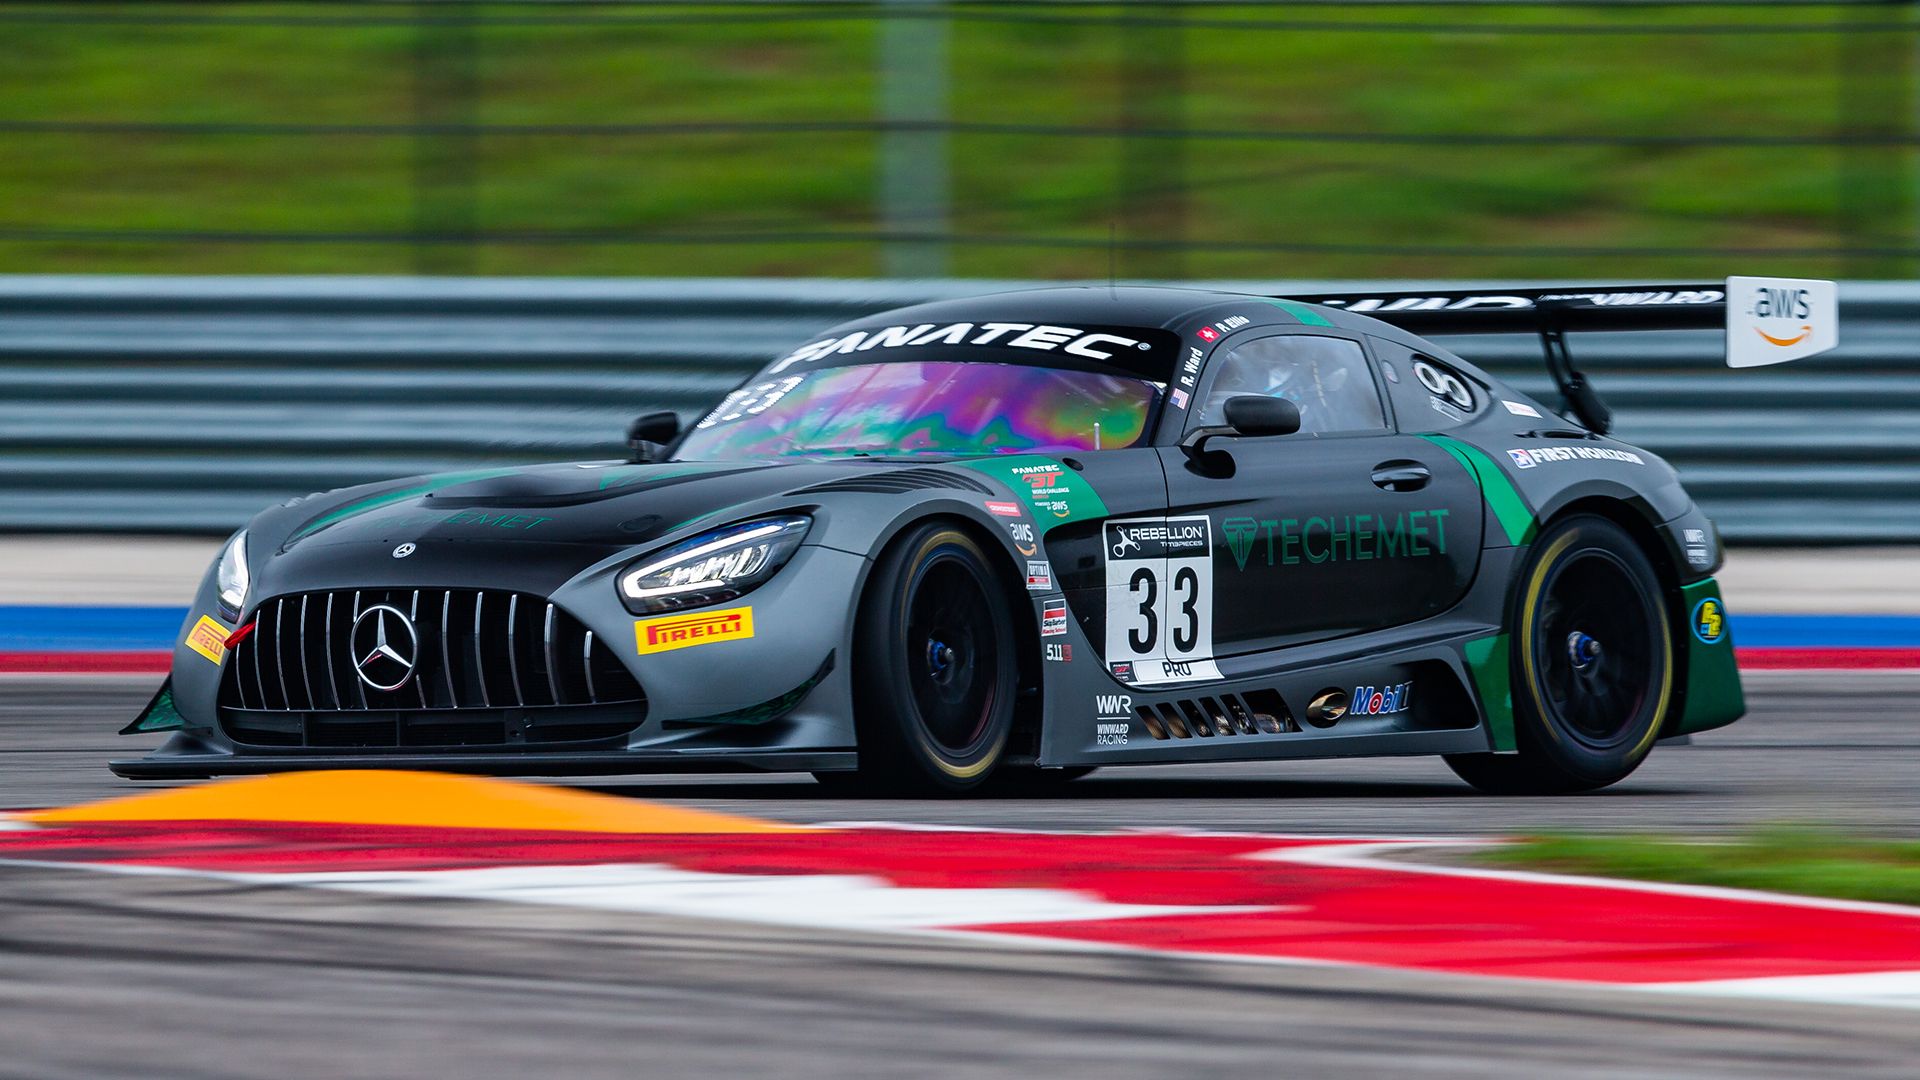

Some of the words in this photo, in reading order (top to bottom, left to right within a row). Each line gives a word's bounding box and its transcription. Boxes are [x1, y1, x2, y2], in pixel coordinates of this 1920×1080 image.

[1755, 287, 1810, 320] aws
[769, 323, 1137, 374] FANATEC
[1184, 346, 1204, 374] Ward
[1529, 447, 1578, 463] FIRST
[1012, 465, 1059, 474] FANATEC
[1010, 523, 1033, 542] aws
[1130, 526, 1203, 541] REBELLION
[1260, 509, 1449, 566] TECHEMET
[1129, 567, 1198, 654] 33
[646, 614, 742, 646] PIRELLI
[1161, 662, 1193, 678] PRO
[1096, 723, 1130, 735] WINWARD
[1096, 734, 1128, 745] RACING
